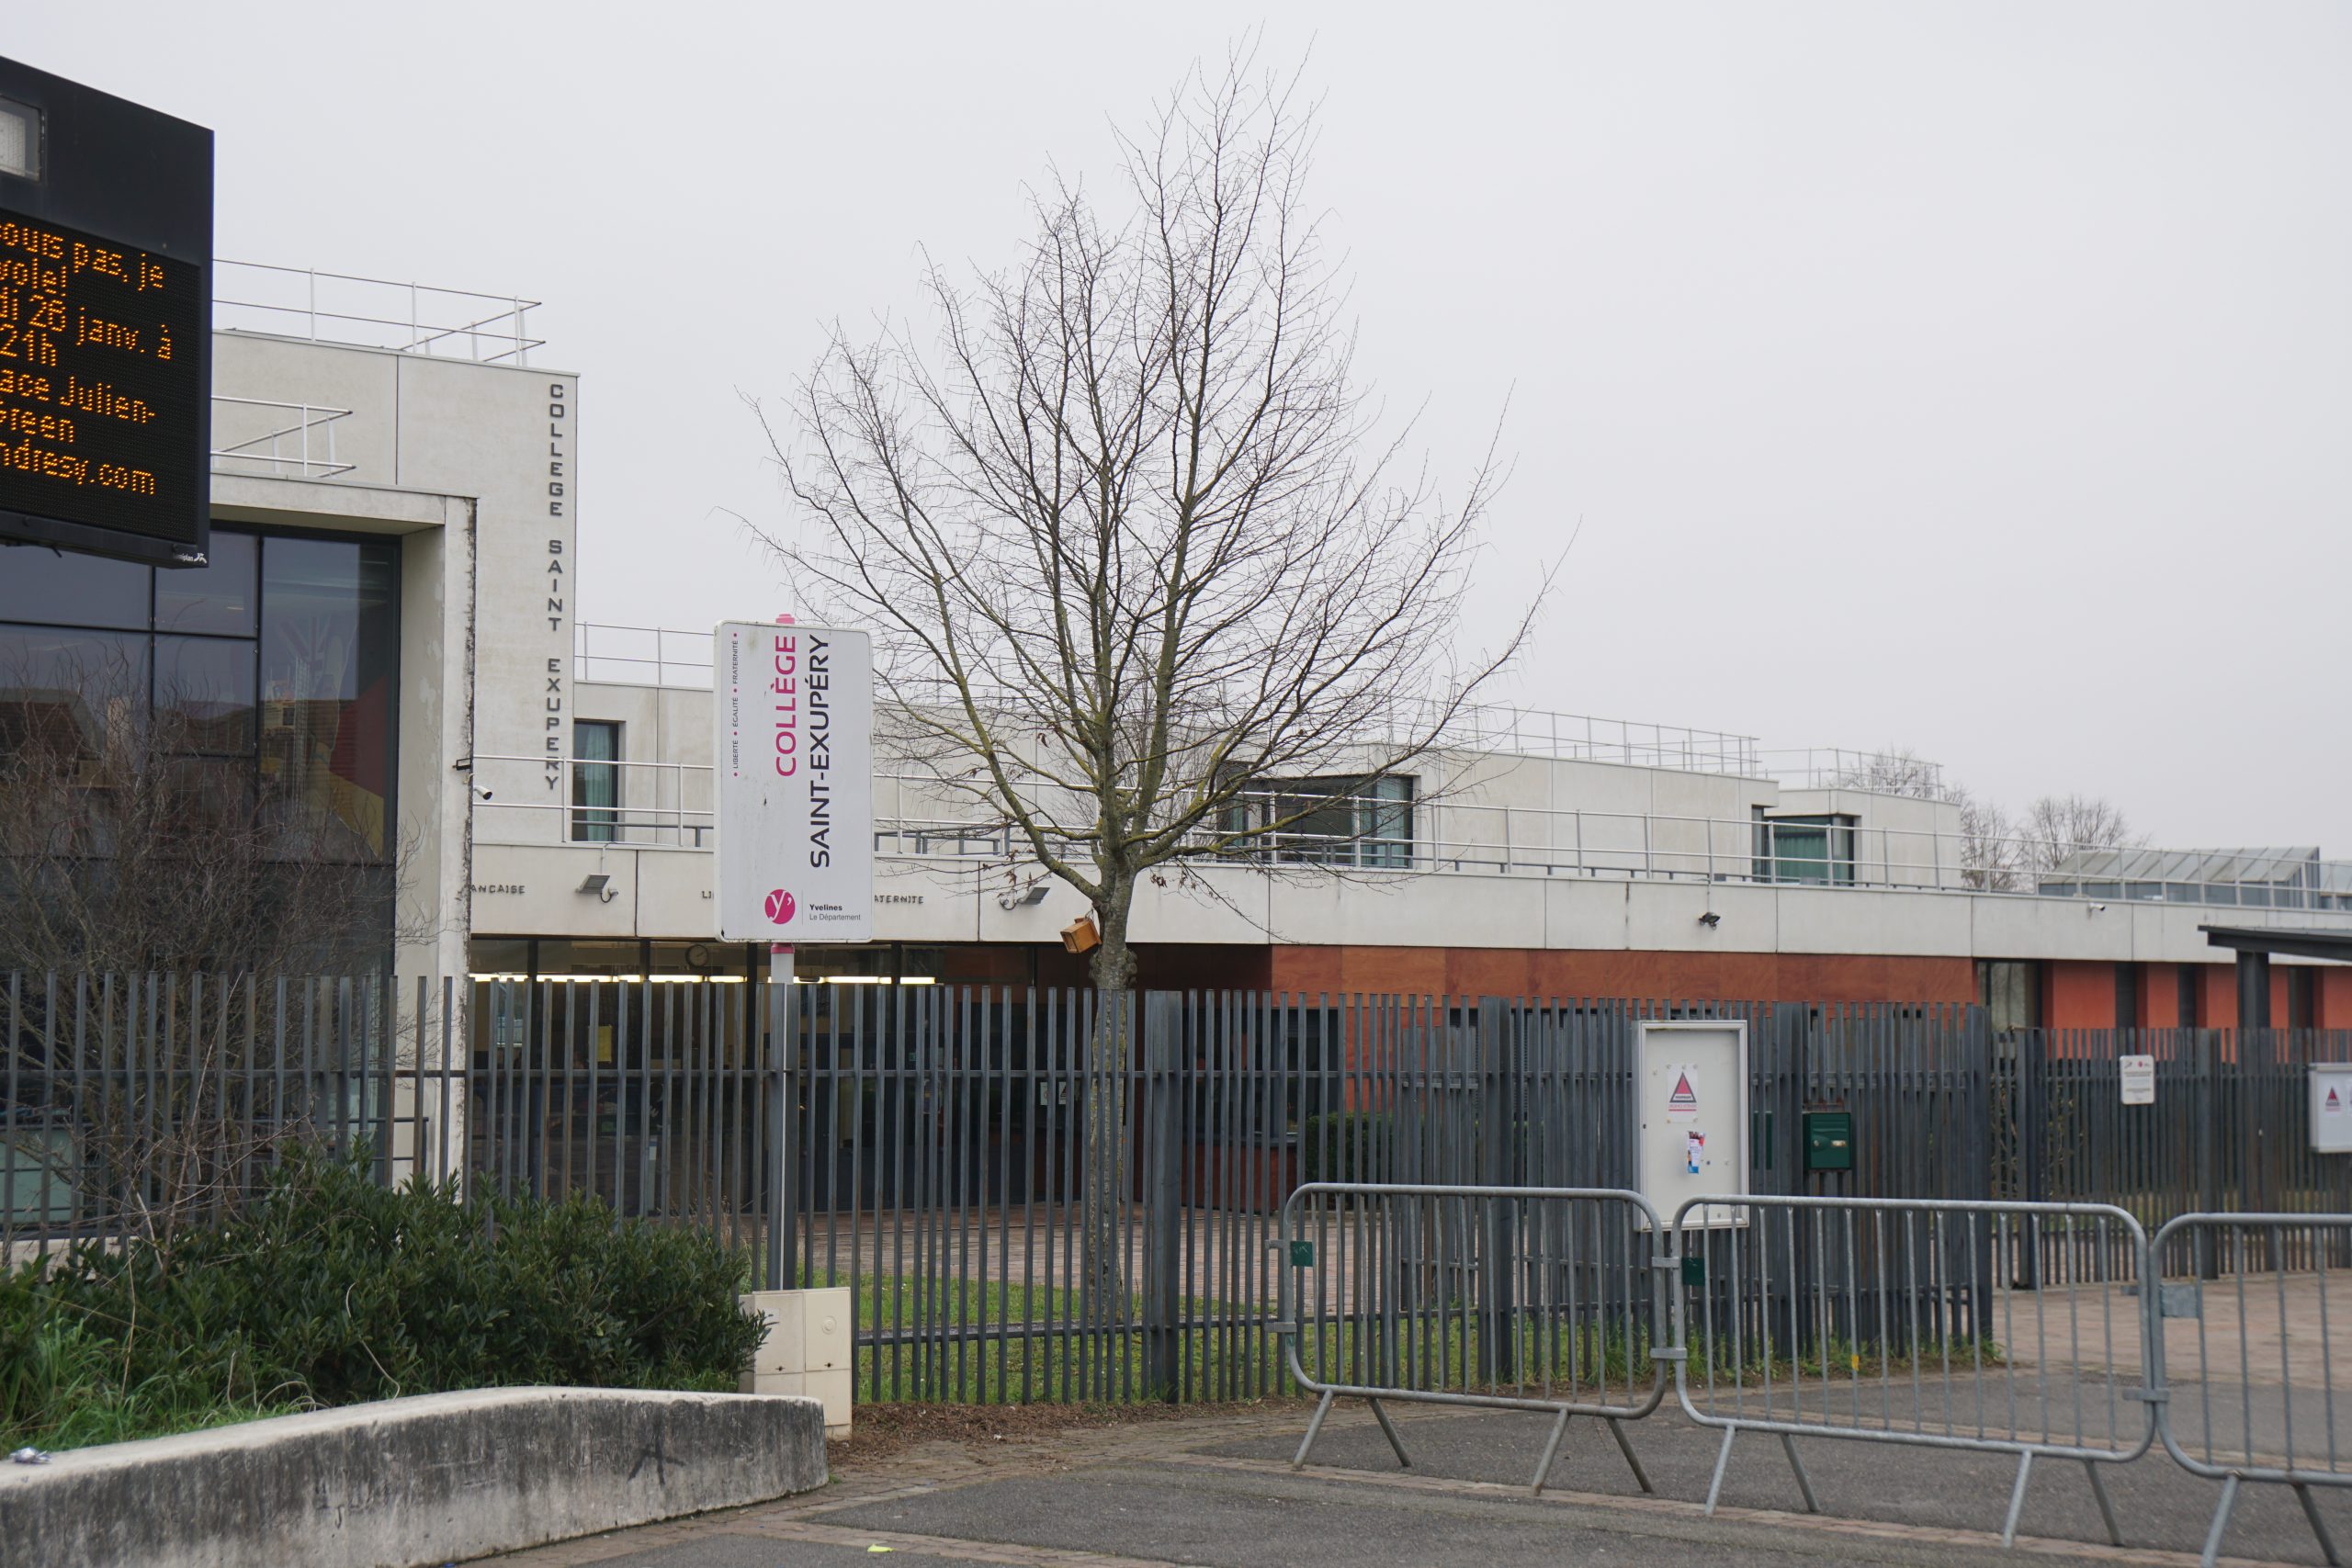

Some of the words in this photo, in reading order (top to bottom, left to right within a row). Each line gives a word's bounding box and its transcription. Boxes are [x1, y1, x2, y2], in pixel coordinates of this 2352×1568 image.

[74, 243, 128, 283] pas,
[138, 253, 164, 292] je
[28, 294, 66, 333] 26
[76, 306, 144, 353] janv.
[157, 323, 171, 359] à
[548, 384, 565, 517] COLLEGE
[548, 539, 563, 632] SAINT
[545, 658, 560, 790] EXUPERY
[770, 635, 797, 777] COLLÈGE
[805, 633, 830, 868] SAINT-EXUPÉRY
[470, 885, 526, 894] ANCAISE
[819, 913, 861, 922] Département
[874, 895, 924, 904] ATERNITE
